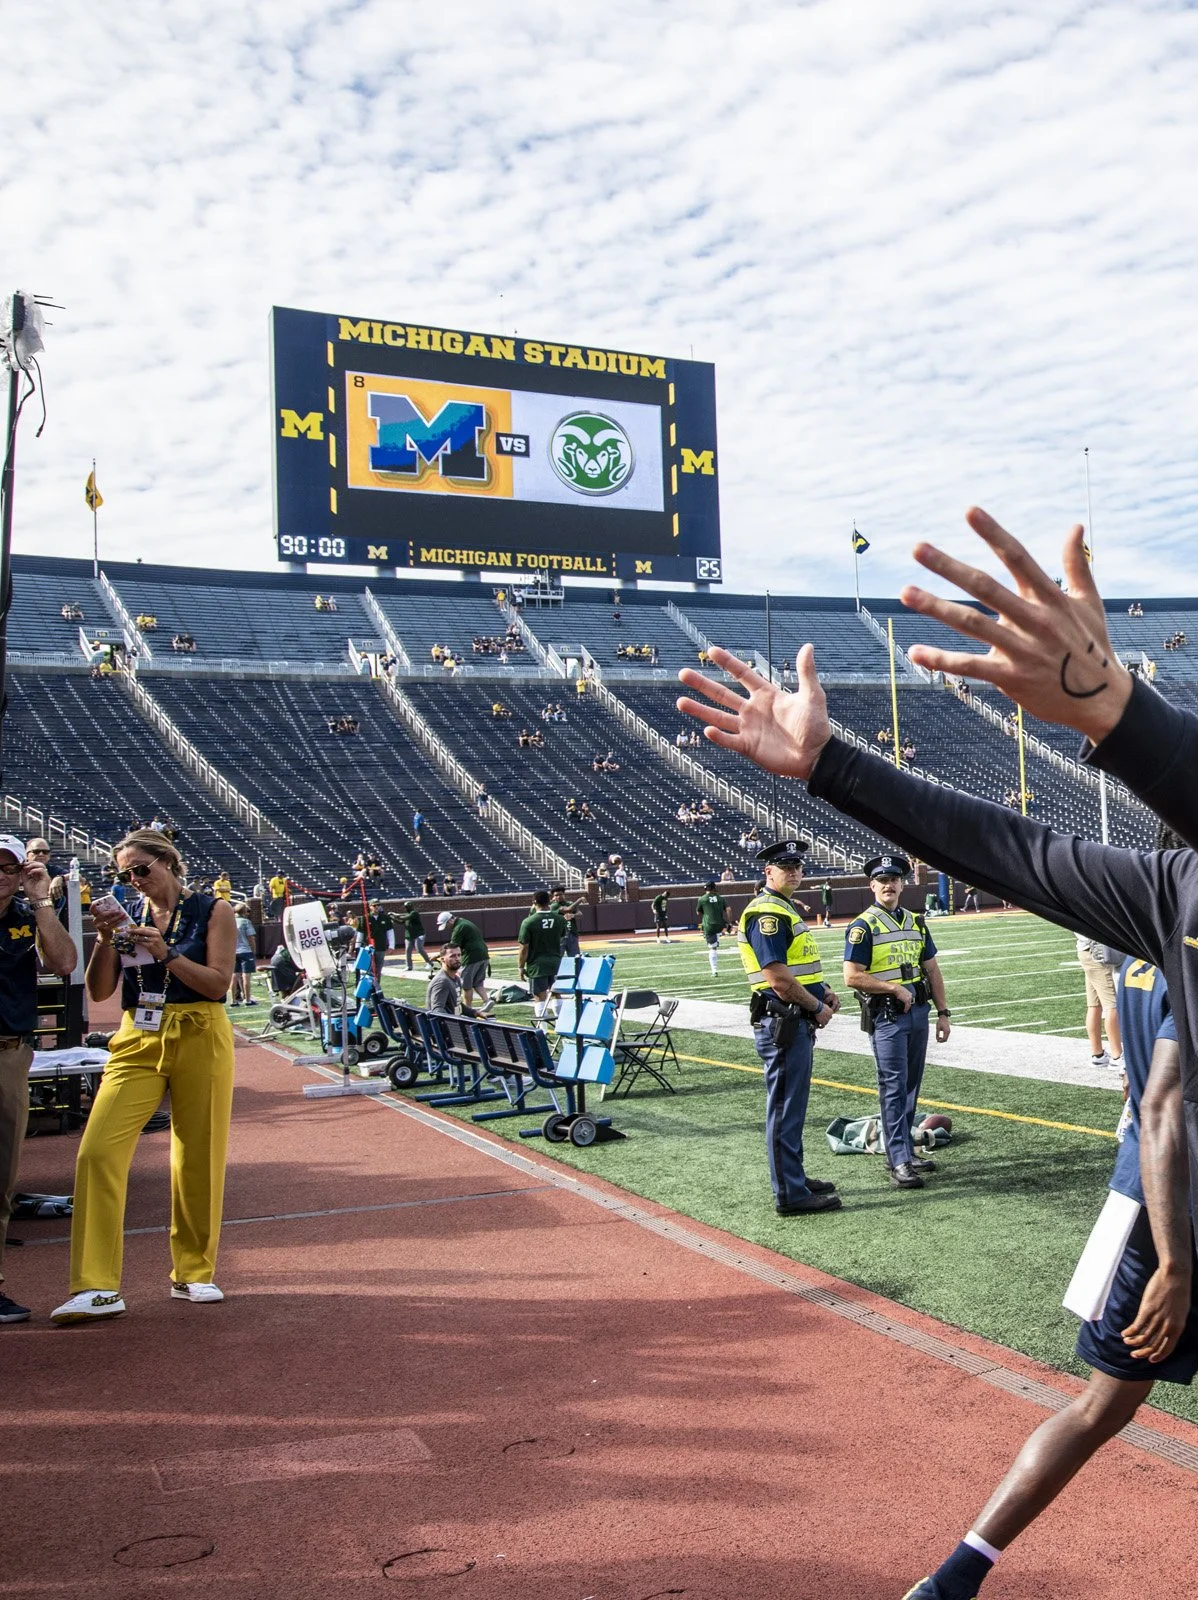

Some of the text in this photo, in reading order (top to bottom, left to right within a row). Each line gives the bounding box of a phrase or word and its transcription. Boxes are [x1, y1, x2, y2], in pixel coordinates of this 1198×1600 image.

[338, 317, 667, 379] MICHIGAN STADIUM
[353, 375, 365, 388] 8
[280, 408, 324, 440] M
[367, 391, 488, 481] M
[499, 436, 527, 454] VS
[680, 447, 715, 476] M
[280, 535, 346, 558] 90:00
[367, 545, 388, 560] M
[420, 547, 607, 572] MICHIGAN FOOTBALL
[635, 560, 653, 574] M
[699, 560, 721, 578] 25
[541, 918, 555, 929] 27
[8, 924, 33, 940] M
[298, 927, 319, 940] BIG
[300, 936, 323, 949] FOGG
[890, 940, 920, 954] STATE
[887, 951, 921, 966] POLIC
